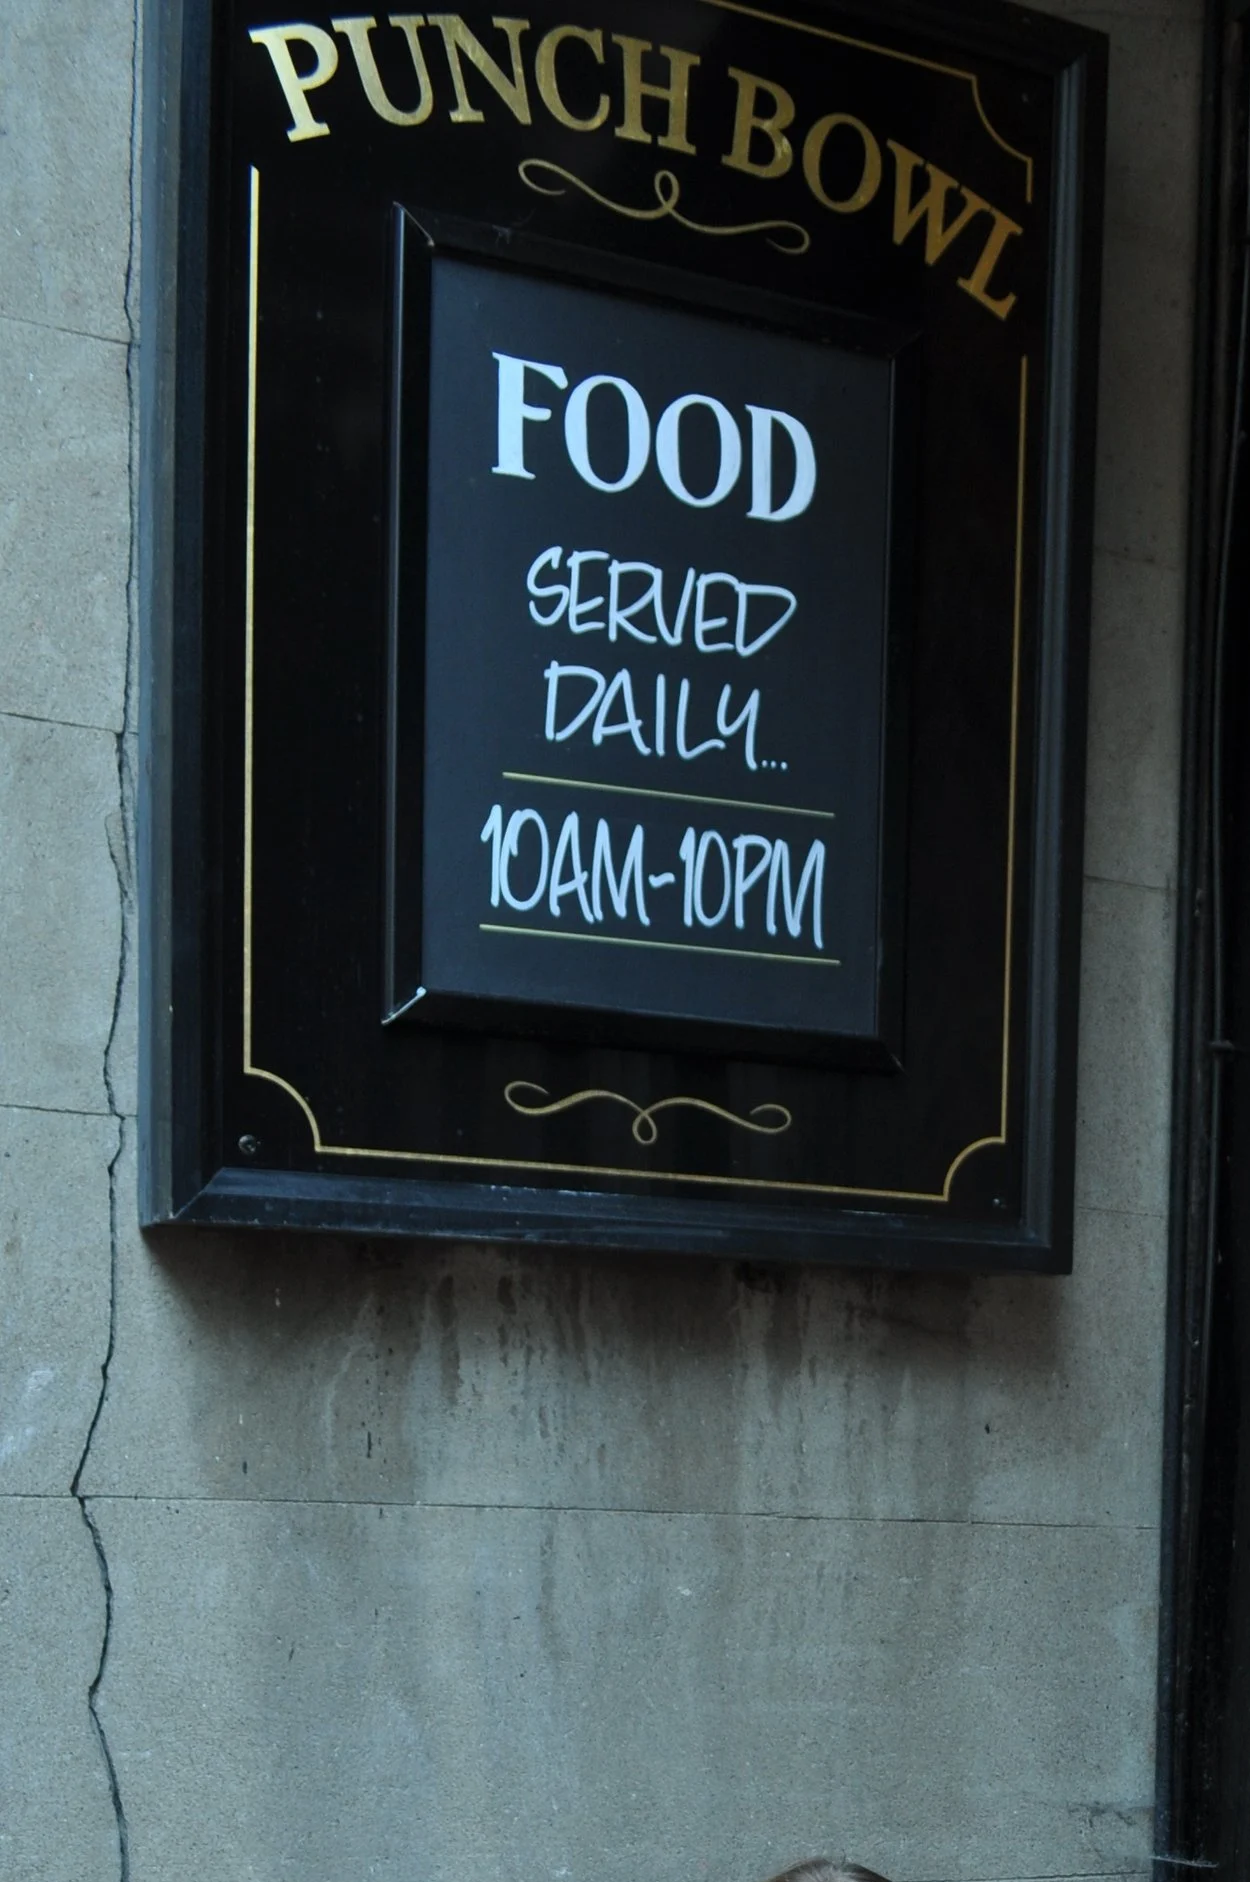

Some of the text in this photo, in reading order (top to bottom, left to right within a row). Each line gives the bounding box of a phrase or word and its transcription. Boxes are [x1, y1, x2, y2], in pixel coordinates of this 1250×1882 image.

[249, 13, 1024, 321] PUNCH BOWL
[490, 350, 818, 525] FOOD
[526, 545, 797, 658] SERVED
[480, 804, 826, 951] 10AM-10PM
